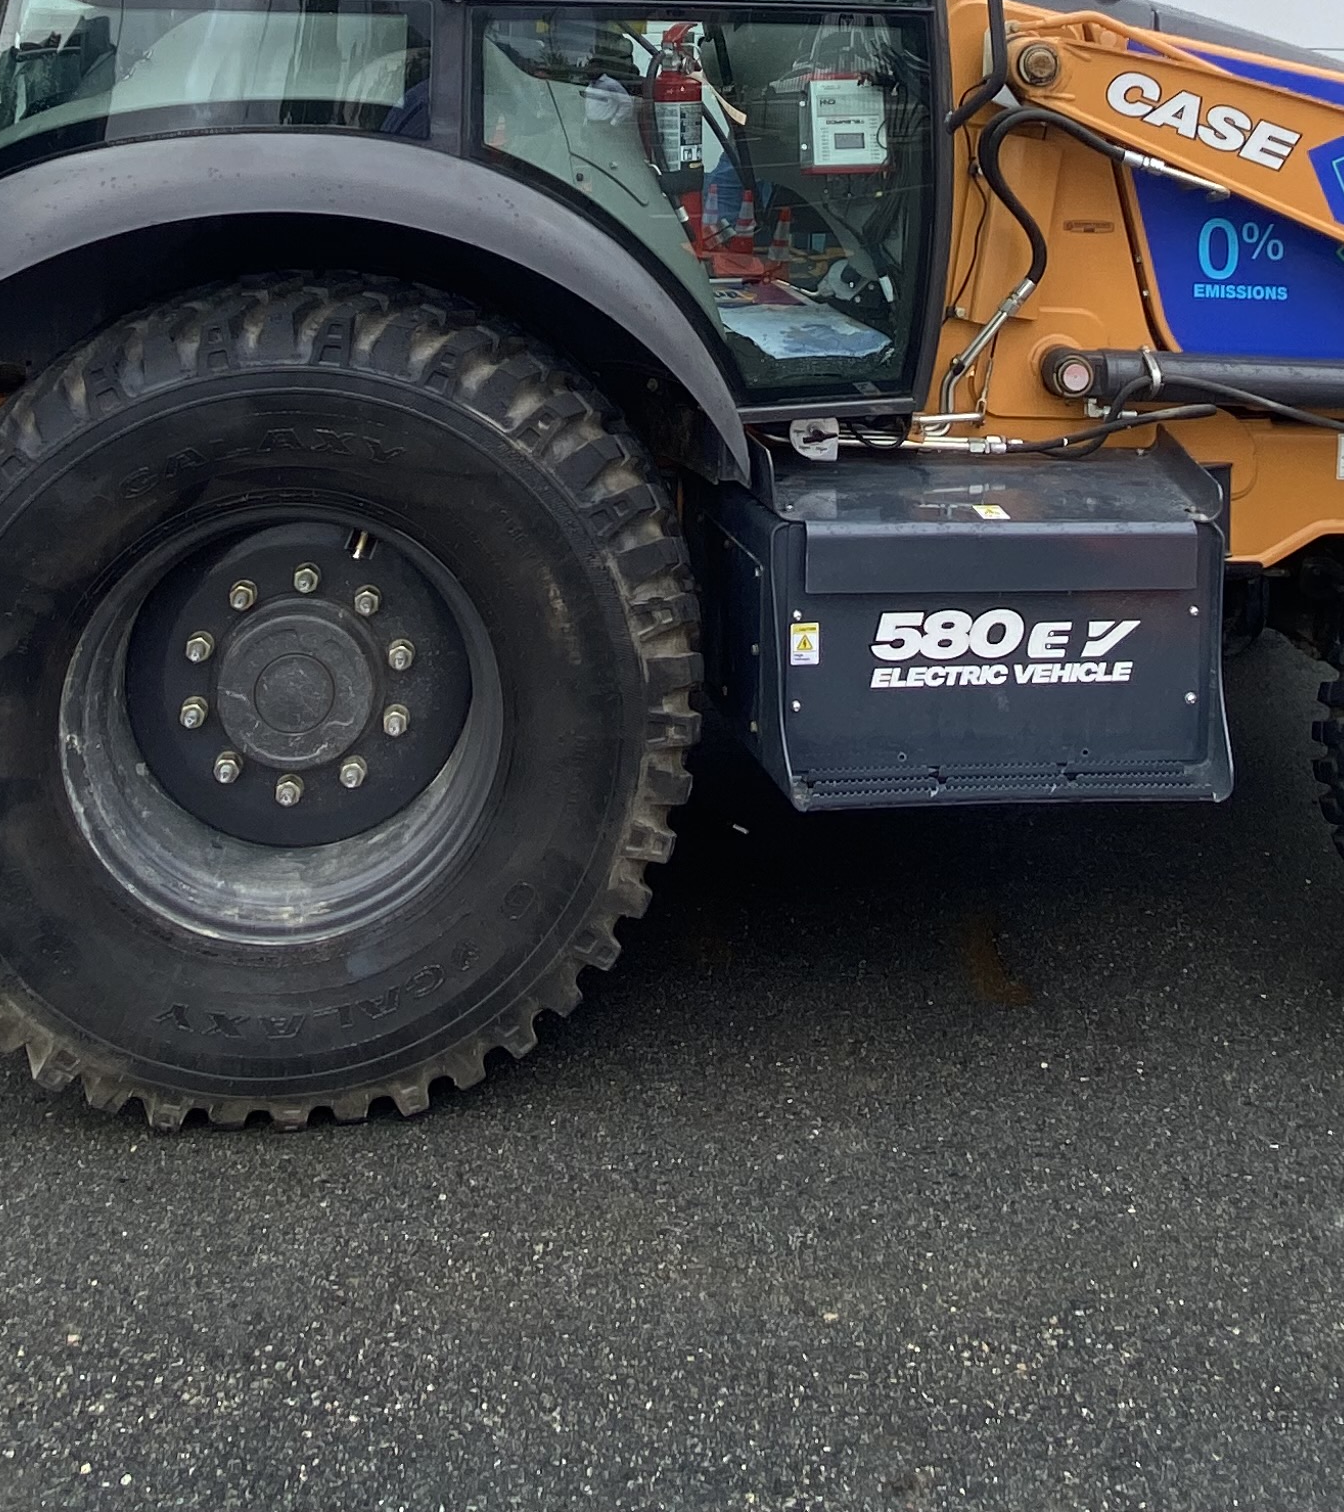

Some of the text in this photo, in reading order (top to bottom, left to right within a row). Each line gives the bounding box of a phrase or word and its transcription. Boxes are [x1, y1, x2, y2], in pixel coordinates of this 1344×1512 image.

[1105, 71, 1301, 171] CASE
[1199, 218, 1284, 280] 0%
[1194, 284, 1288, 301] EMISSIONS
[121, 425, 408, 500] GALAXY
[870, 661, 1134, 688] ELECTRIC VEHICLE
[153, 963, 449, 1040] GALAXY
